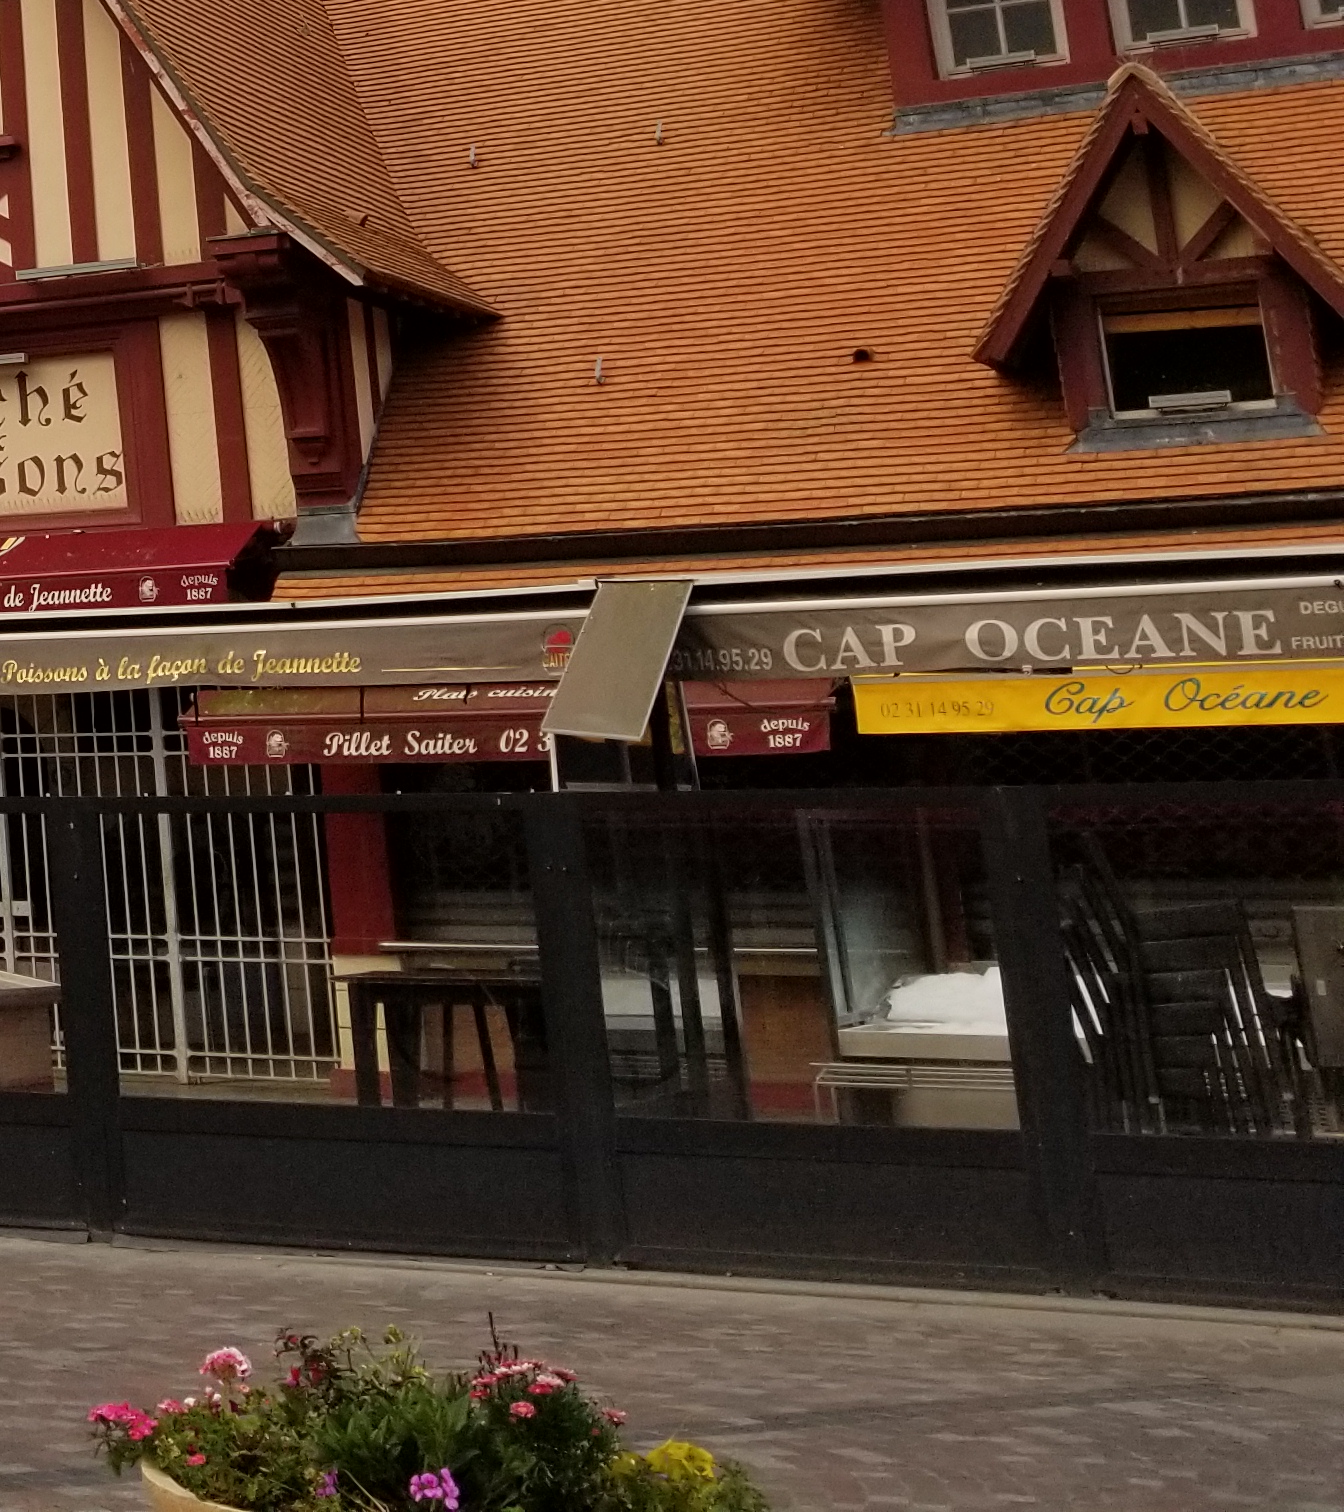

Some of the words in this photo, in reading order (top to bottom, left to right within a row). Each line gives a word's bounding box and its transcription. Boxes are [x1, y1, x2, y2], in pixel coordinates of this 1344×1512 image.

[181, 573, 219, 588] depuis
[3, 586, 24, 608] de
[28, 582, 113, 613] Jeannette
[186, 588, 214, 601] 1887
[1299, 599, 1344, 615] DEGU
[783, 623, 916, 672] CAP
[964, 609, 1283, 662] OCEANE
[1291, 633, 1344, 650] FRUIT
[0, 659, 89, 685] Poissons
[95, 658, 111, 682] à
[116, 656, 142, 680] la
[146, 654, 207, 685] façon
[217, 651, 245, 675] de
[250, 649, 363, 683] Jeannette
[413, 687, 478, 702] Plats
[1044, 681, 1136, 725] Cap
[1163, 677, 1330, 713] Océane
[880, 702, 899, 718] 02
[905, 701, 922, 718] 31
[930, 700, 947, 716] 14
[952, 700, 970, 716] 95
[976, 699, 994, 717] 29
[760, 715, 811, 732] depuis
[202, 731, 244, 746] depuis
[323, 731, 393, 757] Pillet
[404, 730, 478, 756] Saiter
[499, 728, 529, 753] 02
[768, 733, 803, 748] 1887
[208, 746, 238, 759] 1887
